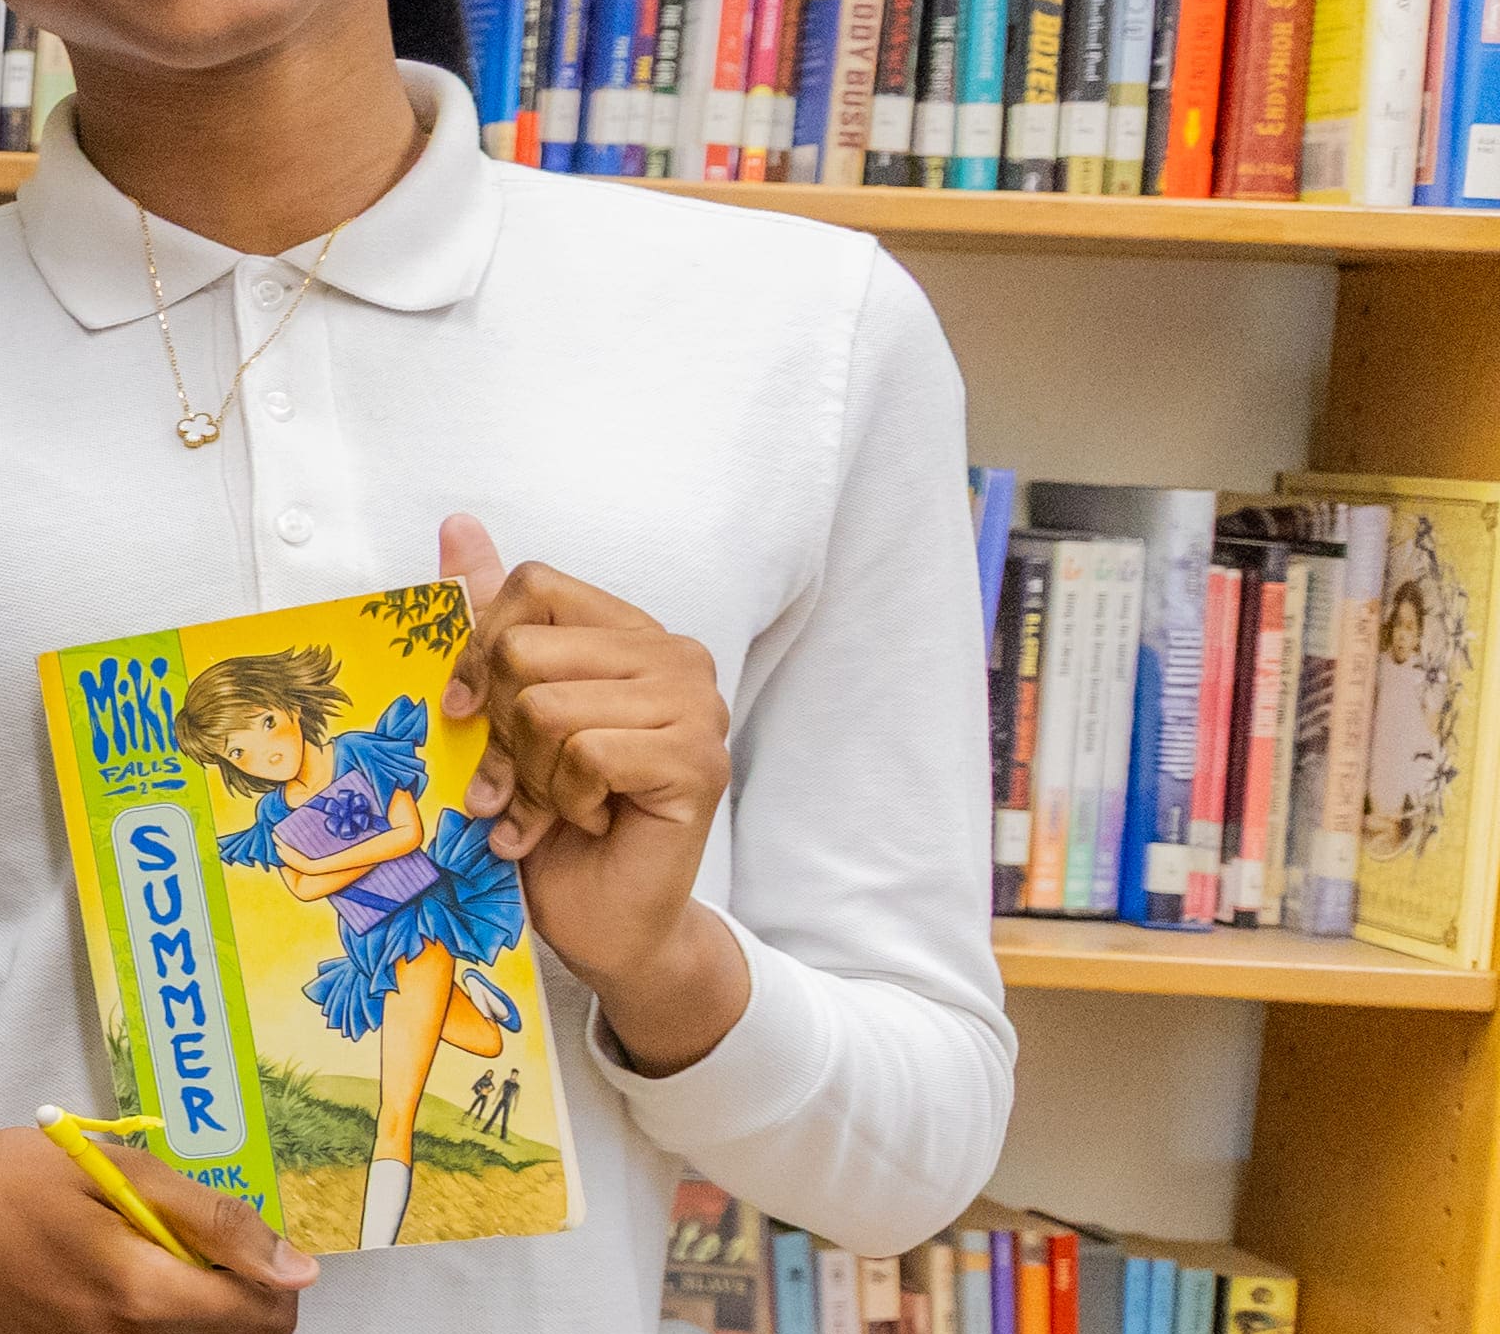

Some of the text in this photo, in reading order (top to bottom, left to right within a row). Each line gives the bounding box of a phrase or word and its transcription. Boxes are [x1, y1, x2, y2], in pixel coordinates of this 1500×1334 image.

[1025, 9, 1063, 106] BOXES
[838, 71, 874, 150] BUSH
[98, 755, 183, 784] FALLS
[128, 823, 229, 1135] SUMMER
[178, 1165, 249, 1190] ARK
